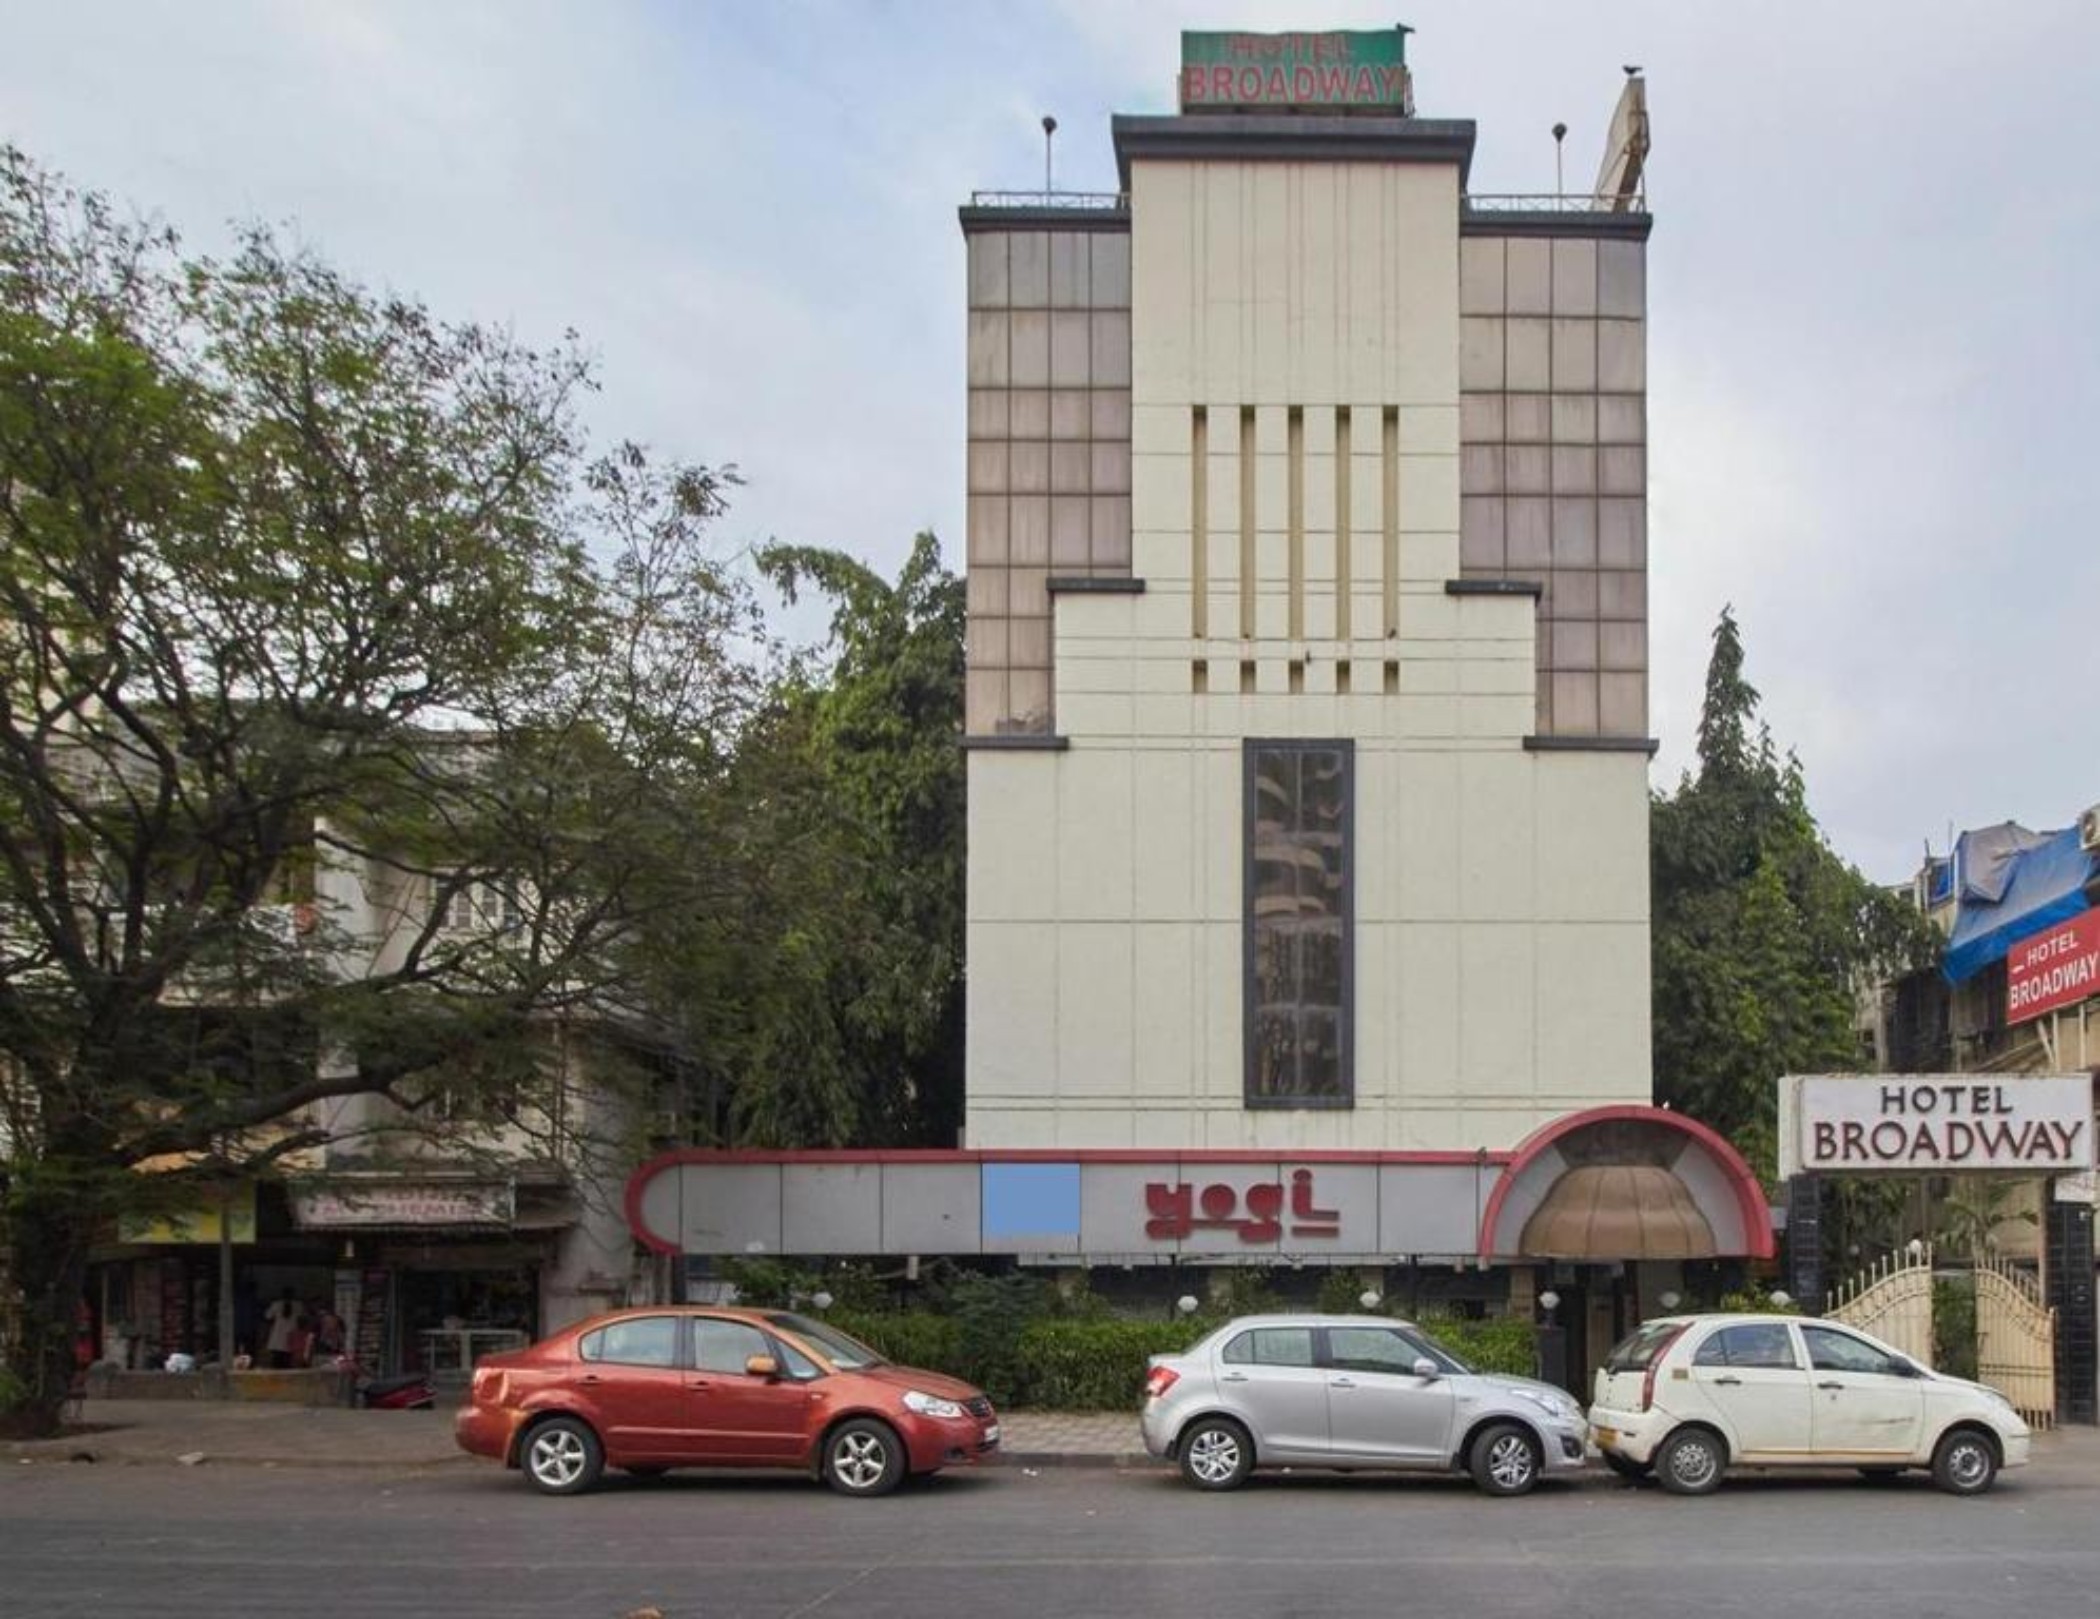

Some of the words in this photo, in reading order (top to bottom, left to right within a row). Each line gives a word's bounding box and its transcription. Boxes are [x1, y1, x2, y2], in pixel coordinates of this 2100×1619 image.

[1231, 34, 1348, 62] HOTEL
[1186, 65, 1400, 102] BROADWAY
[2027, 930, 2079, 967] HOTEL
[2010, 951, 2099, 1009] BROADWAY
[1880, 1086, 2013, 1115] HOTEL
[1814, 1121, 2083, 1161] BROADWAY
